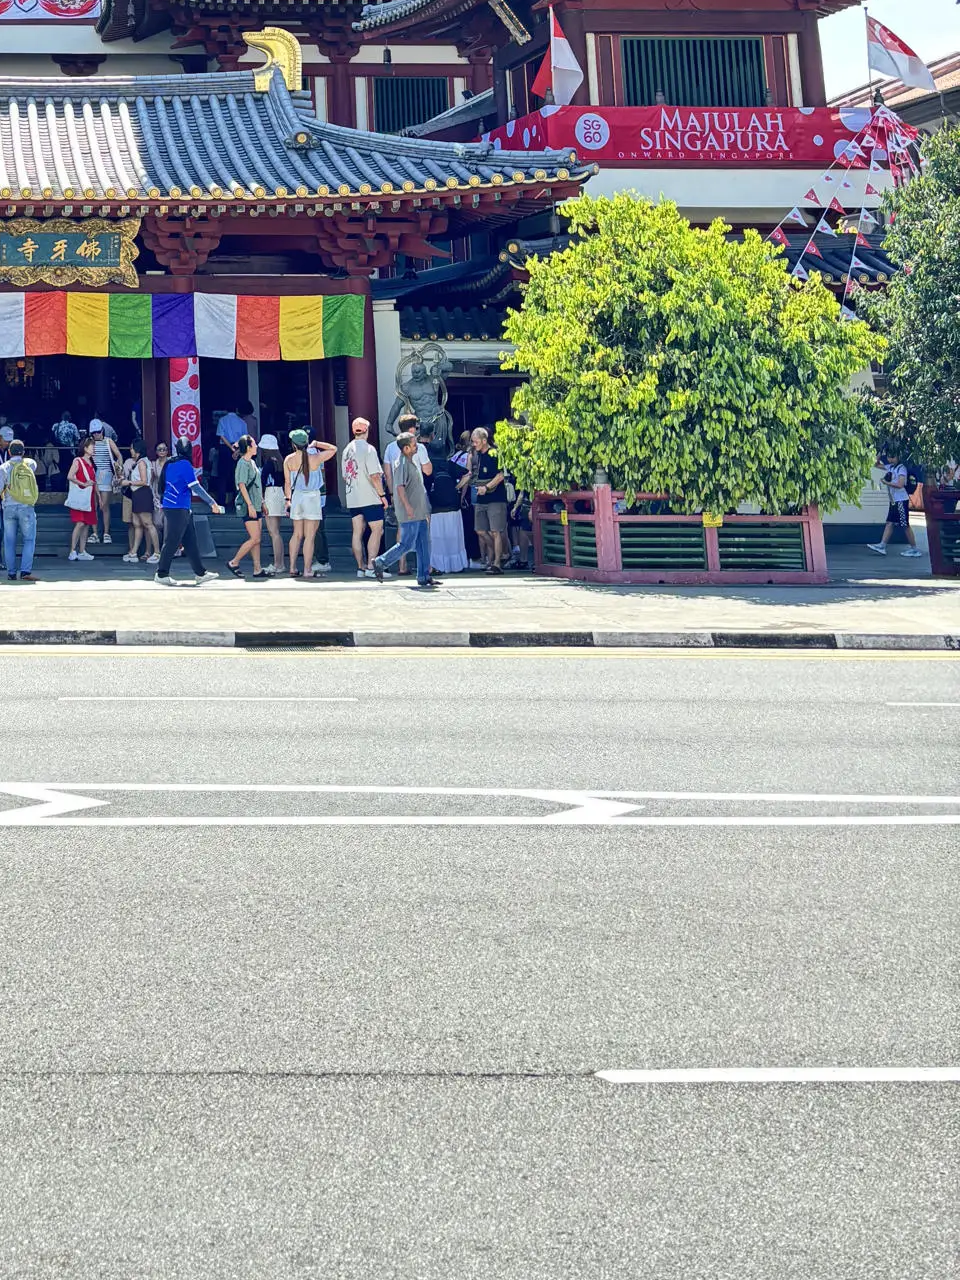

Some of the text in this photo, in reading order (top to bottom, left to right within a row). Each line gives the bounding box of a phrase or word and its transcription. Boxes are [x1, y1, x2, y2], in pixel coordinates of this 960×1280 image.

[583, 120, 601, 130] SG
[659, 107, 785, 137] MAJULAH
[583, 131, 601, 143] 60
[640, 128, 790, 151] SINGAPURA
[618, 151, 685, 159] ONWARD
[17, 237, 102, 263] 佛牙寺
[178, 410, 197, 422] SG
[178, 423, 197, 436] 60
